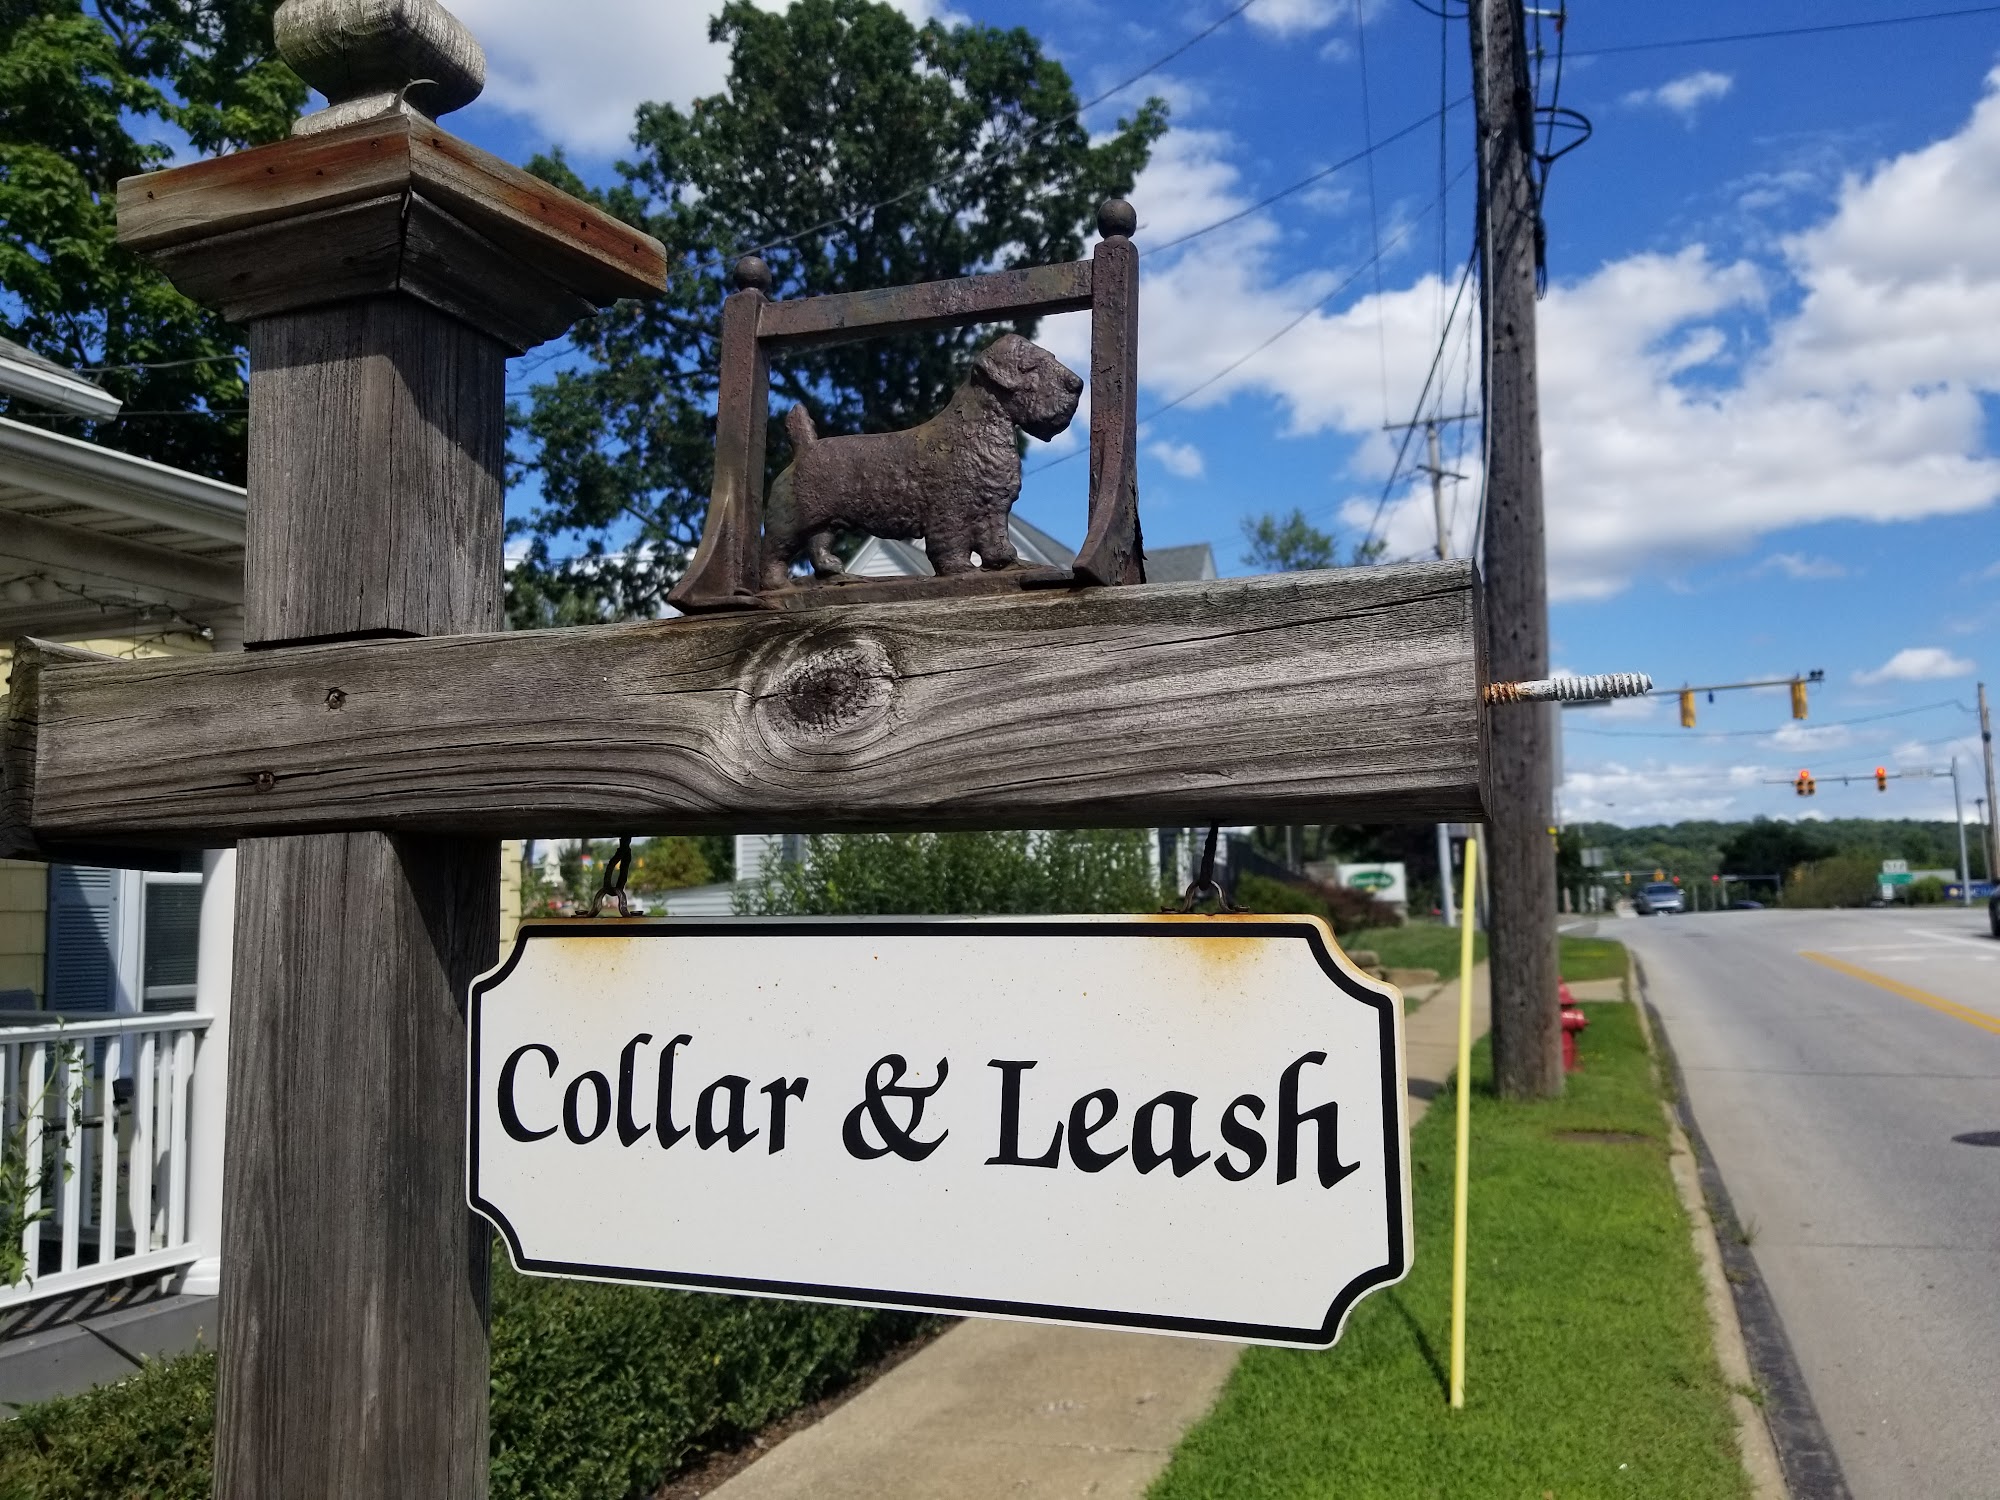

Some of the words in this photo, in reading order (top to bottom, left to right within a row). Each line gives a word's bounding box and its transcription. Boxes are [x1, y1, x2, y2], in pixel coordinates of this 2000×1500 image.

[497, 1032, 809, 1156] Collar
[842, 1053, 949, 1162] &
[984, 1050, 1361, 1190] Leash
